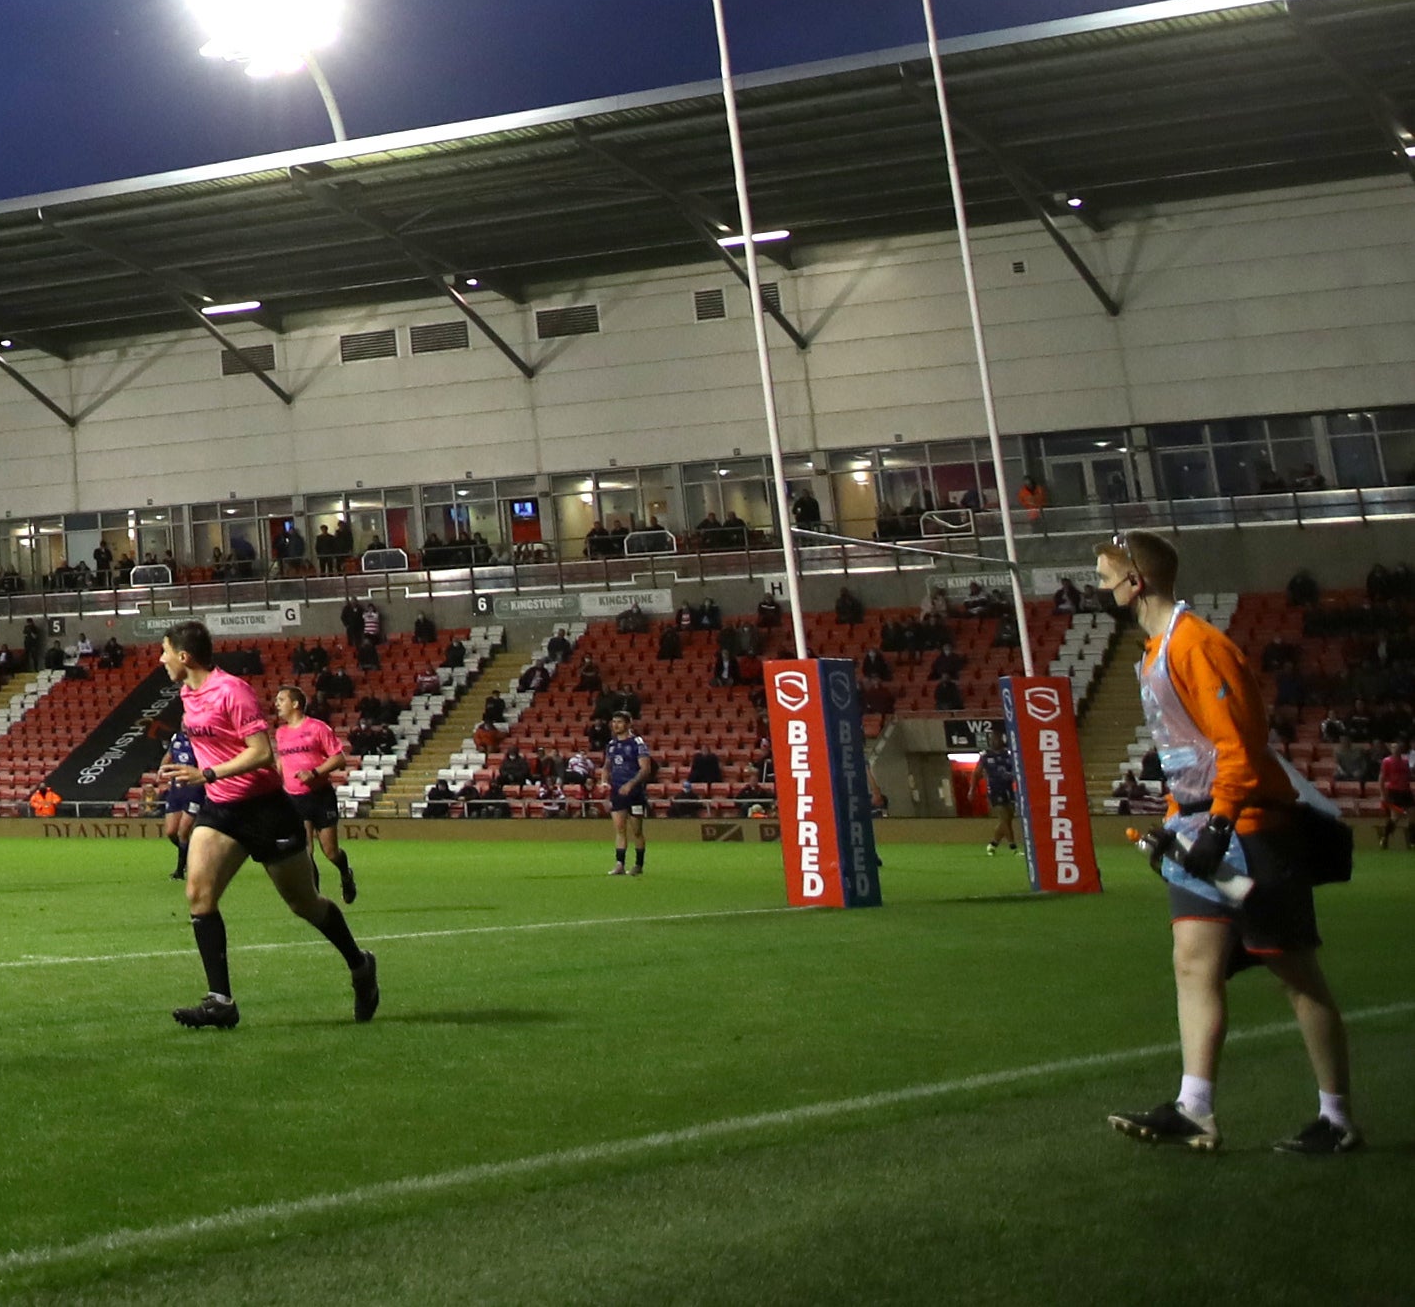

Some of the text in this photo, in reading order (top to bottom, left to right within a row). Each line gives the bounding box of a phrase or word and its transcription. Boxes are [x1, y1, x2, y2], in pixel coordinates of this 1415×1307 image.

[771, 582, 783, 595] H
[477, 597, 488, 611] 6
[510, 598, 563, 610] KINGSTONE
[598, 594, 654, 605] KINGSTONE
[220, 615, 267, 625] KINGSTONE
[285, 608, 296, 621] G
[52, 620, 61, 633] 5
[967, 720, 993, 734] W2
[787, 719, 825, 898] BETFRED
[839, 718, 871, 898] BETFRED
[1038, 729, 1080, 885] BETFRED
[42, 823, 130, 838] DIANE
